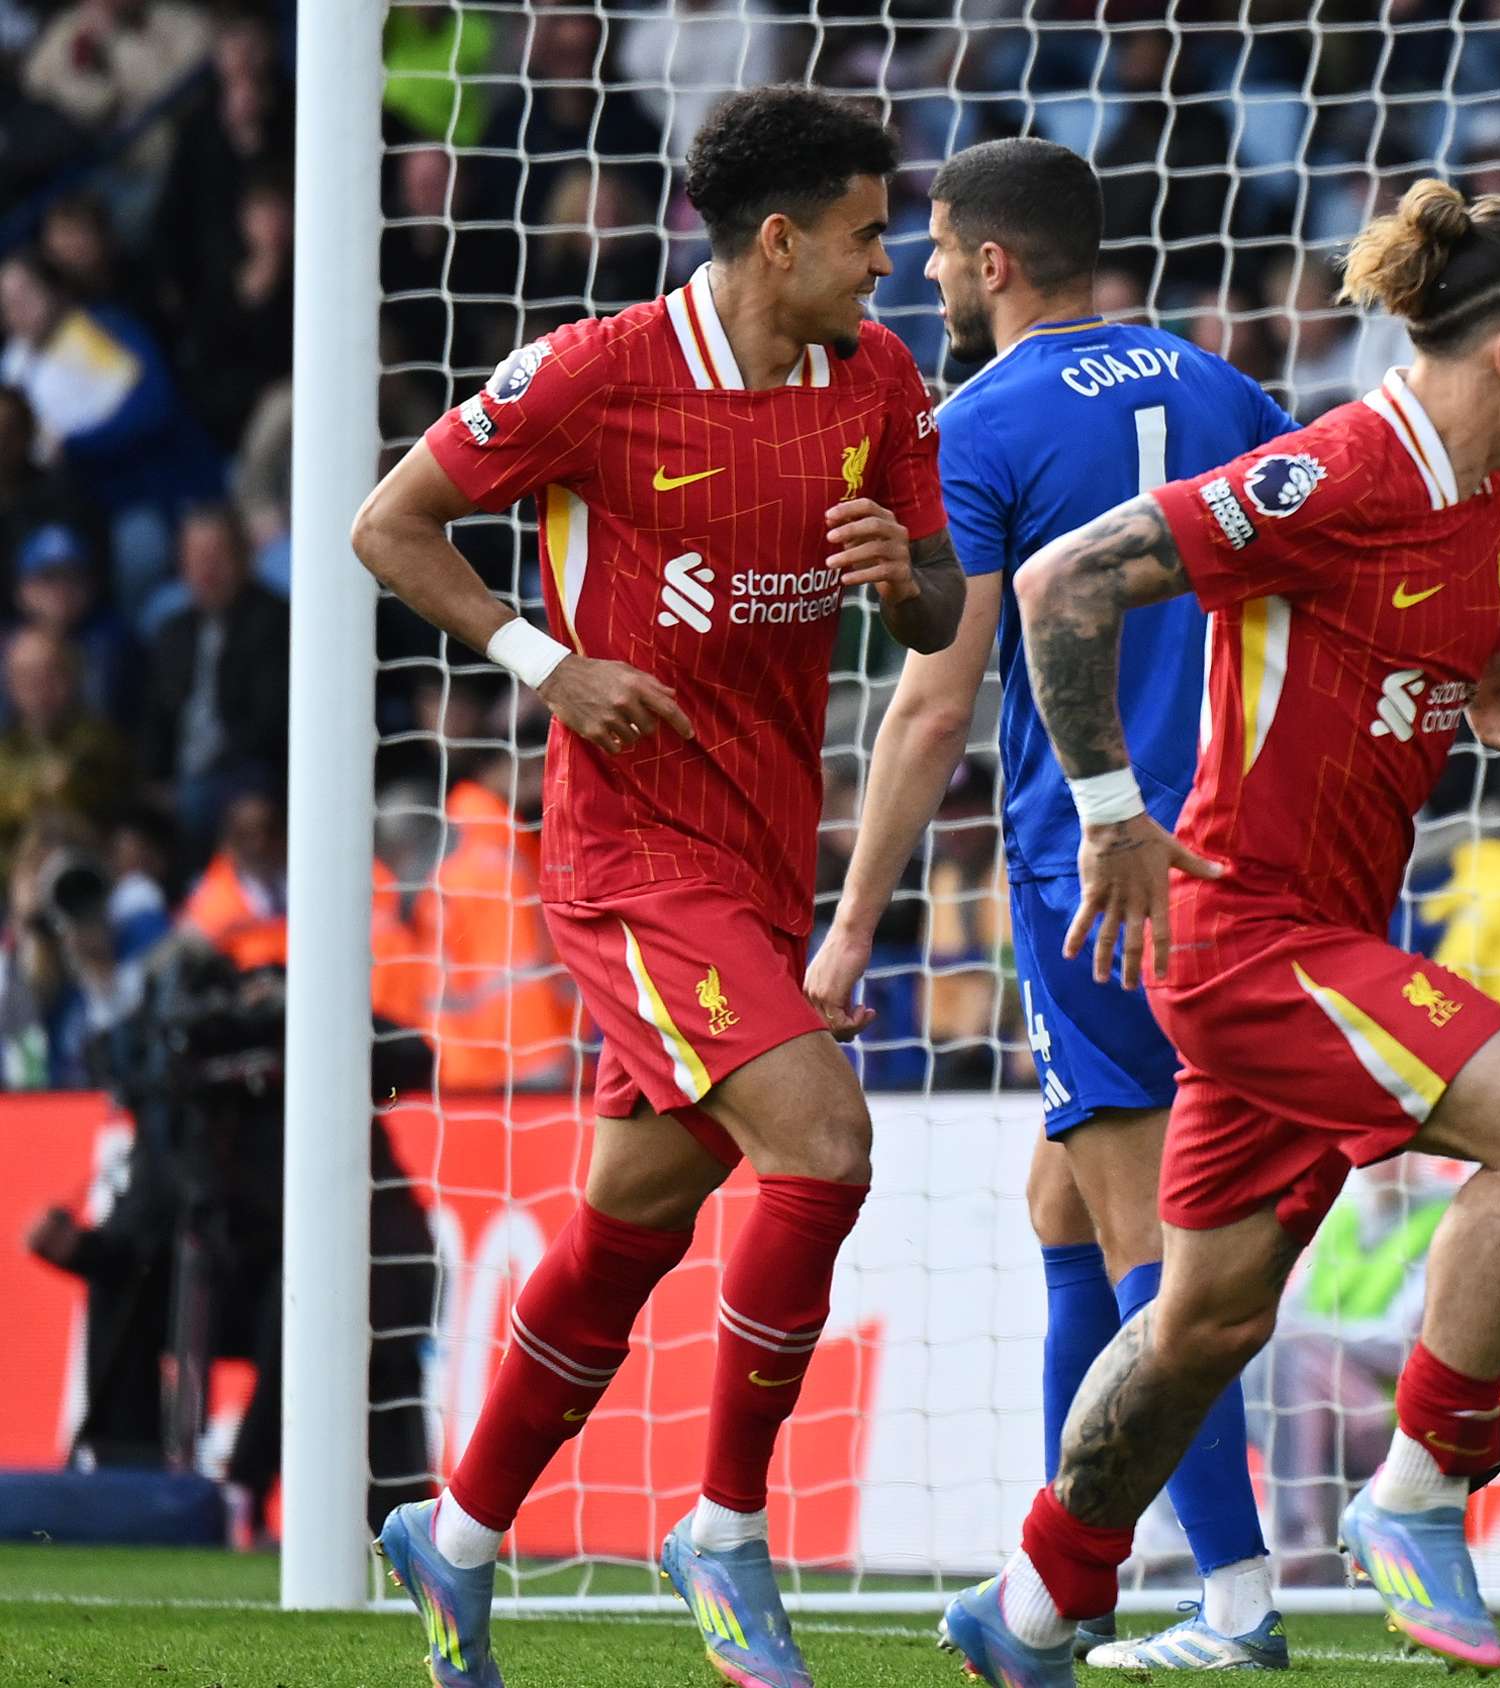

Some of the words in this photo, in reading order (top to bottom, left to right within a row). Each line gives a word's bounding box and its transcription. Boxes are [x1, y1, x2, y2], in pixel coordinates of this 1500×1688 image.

[1061, 347, 1180, 398] COADY
[729, 586, 841, 624] chartered
[1023, 980, 1052, 1062] 4
